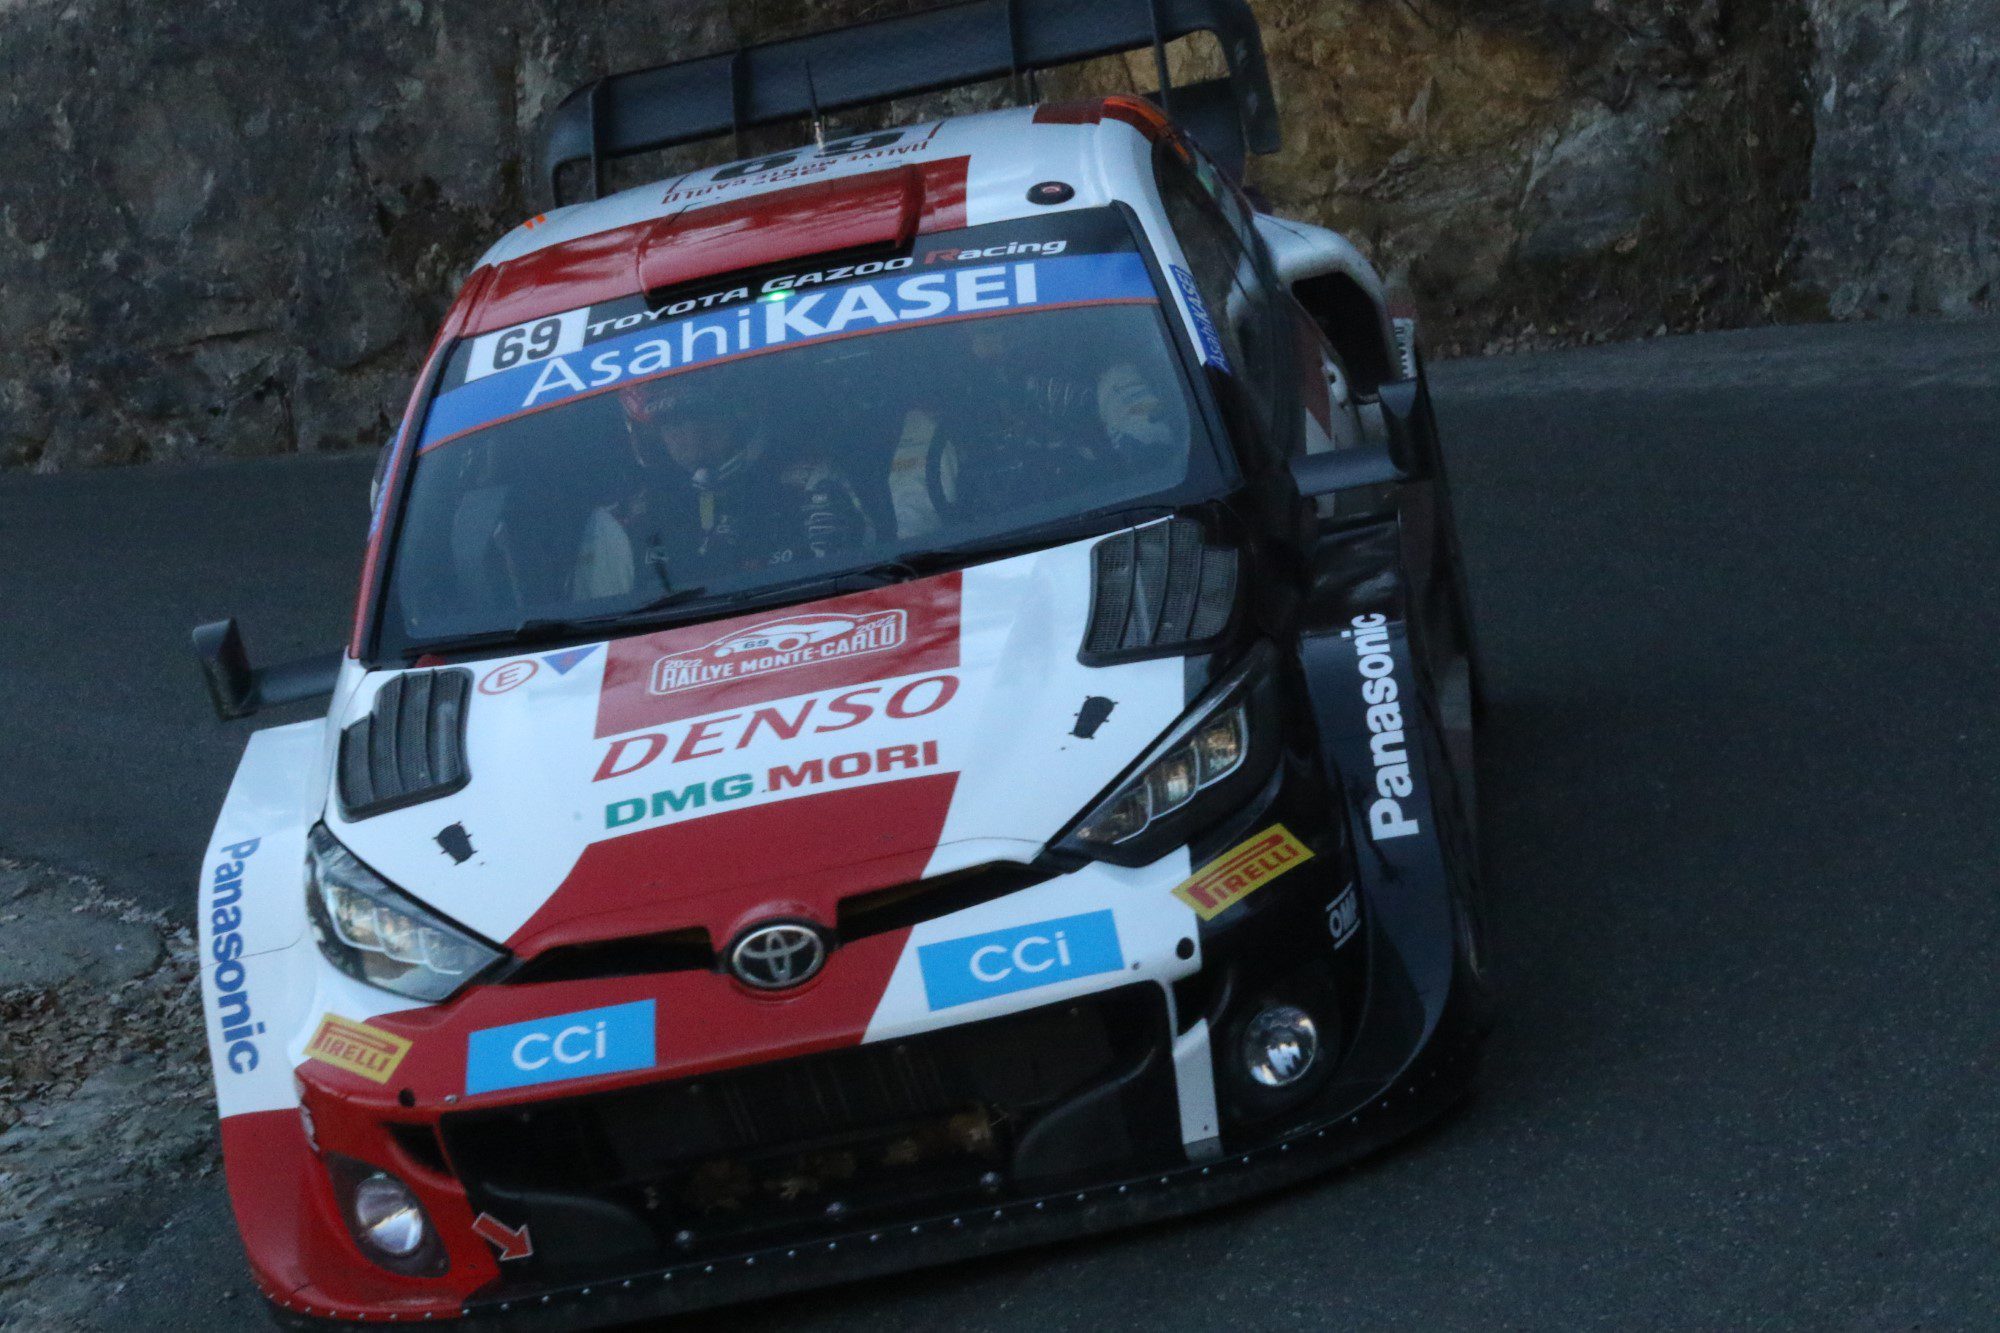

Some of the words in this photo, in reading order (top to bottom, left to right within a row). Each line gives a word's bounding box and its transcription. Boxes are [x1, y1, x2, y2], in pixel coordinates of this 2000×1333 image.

[587, 286, 748, 337] TOYOTA
[761, 256, 913, 293] GAZOO
[923, 240, 1067, 265] Racing
[492, 315, 562, 371] 69
[744, 638, 769, 650] 69
[856, 615, 897, 634] 2022
[495, 666, 521, 688] E
[660, 663, 733, 690] RALLYE
[664, 658, 703, 669] 2022
[592, 676, 960, 784] DENSO
[1341, 612, 1419, 841] Panasonic
[1186, 833, 1301, 909] PIRELLI
[212, 836, 266, 1075] Panasonic
[314, 1021, 400, 1074] PIRELLI
